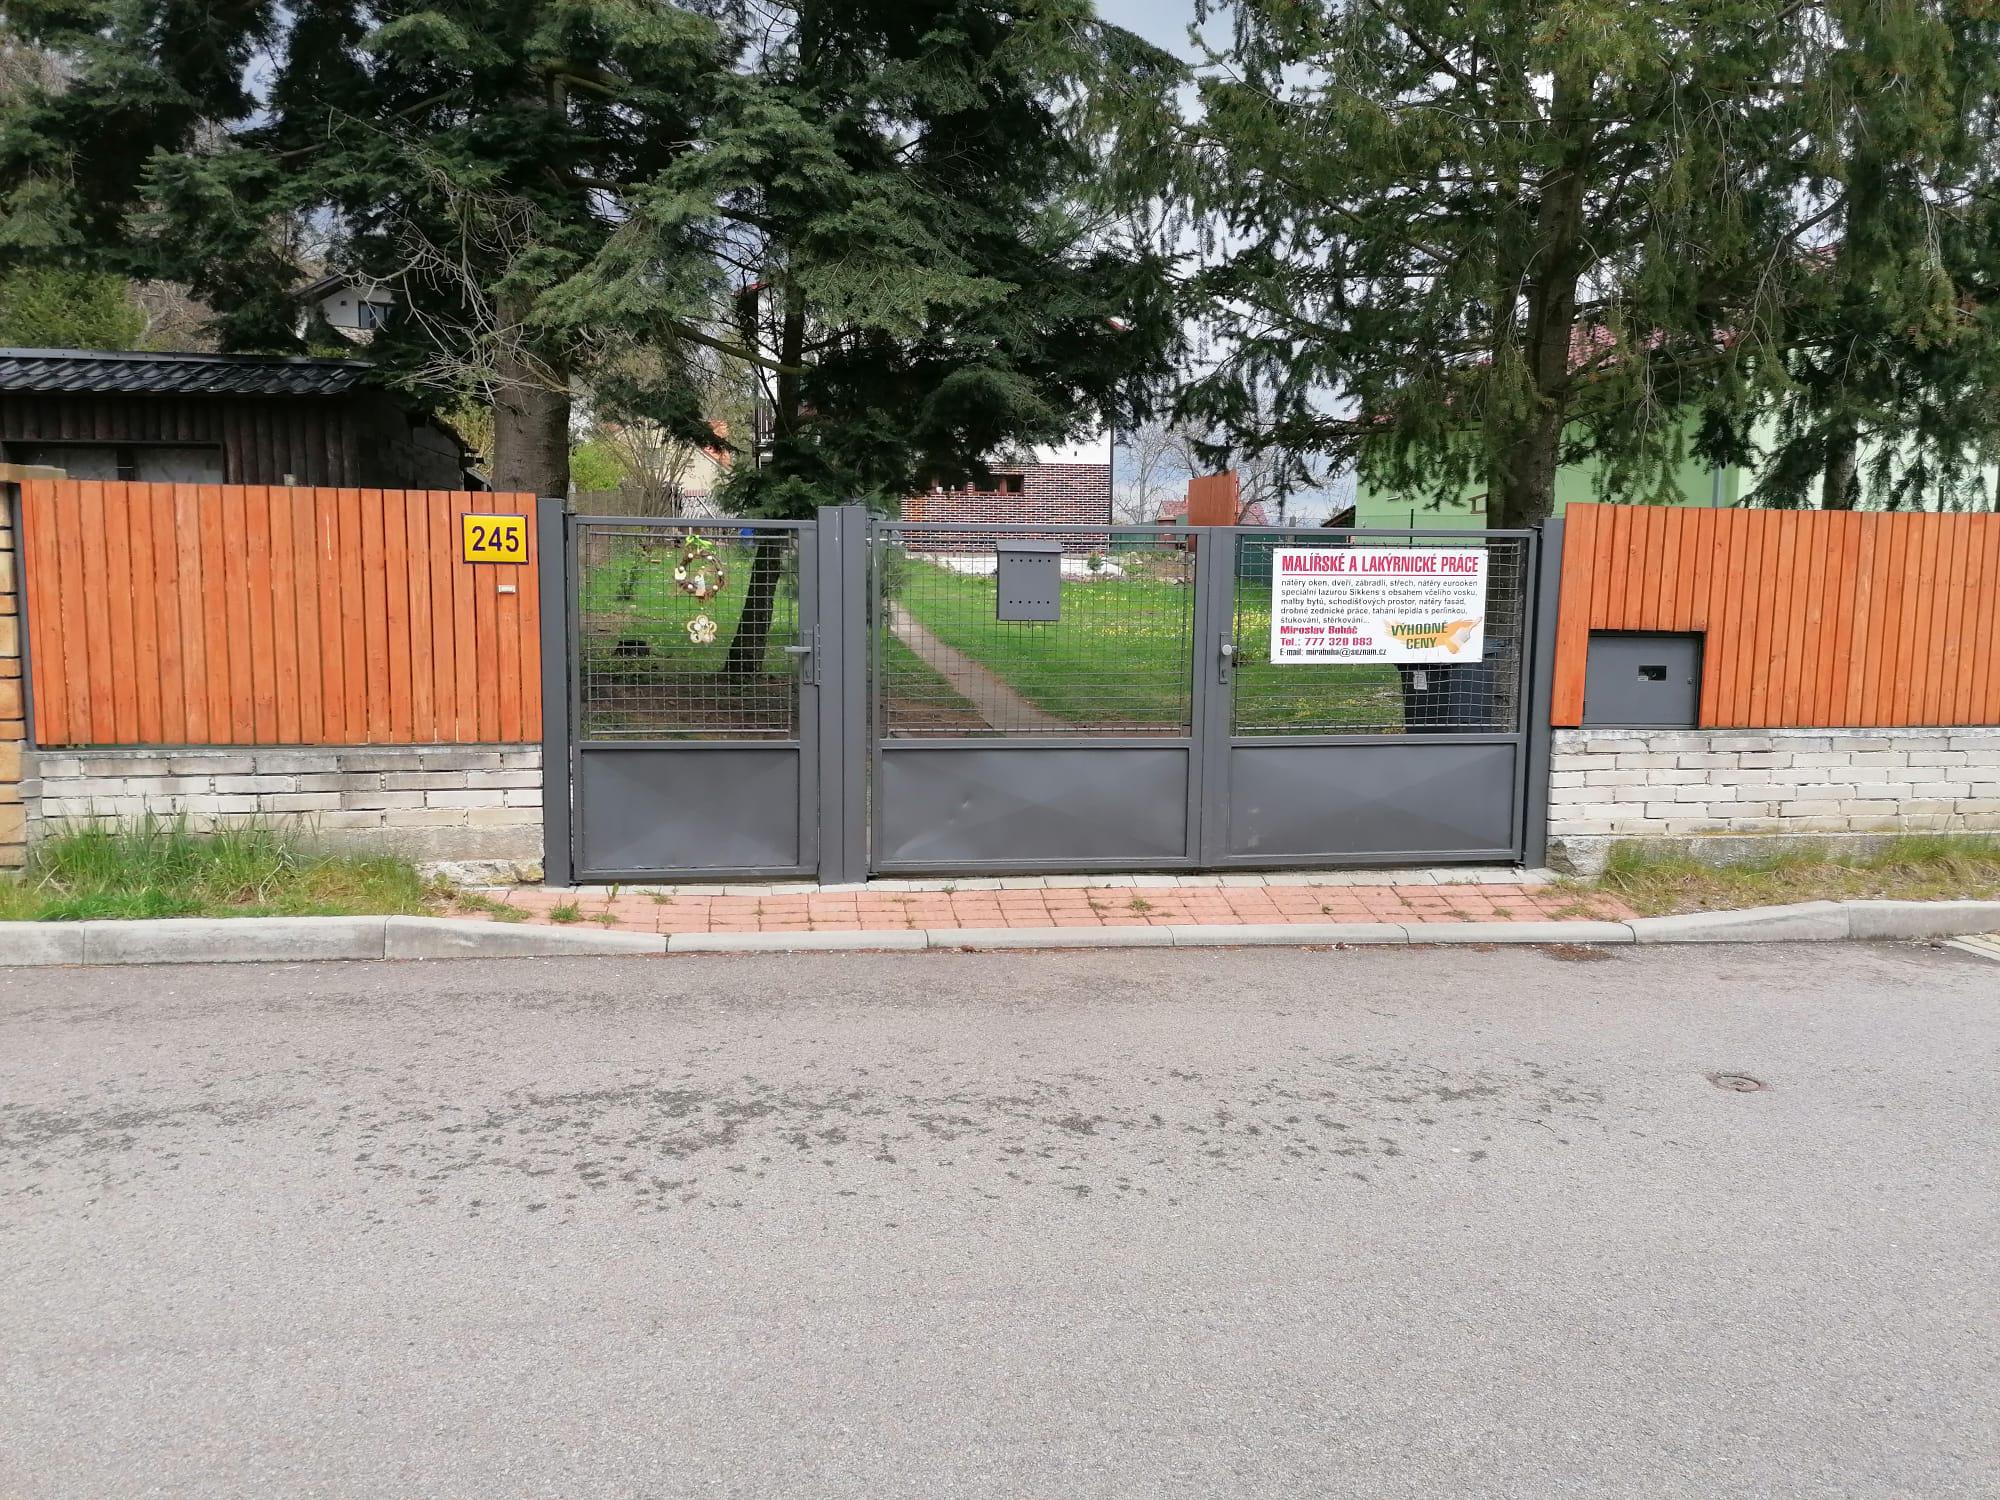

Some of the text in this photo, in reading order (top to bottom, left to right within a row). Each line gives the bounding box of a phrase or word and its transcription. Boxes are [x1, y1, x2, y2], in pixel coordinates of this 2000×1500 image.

[472, 525, 520, 552] 245
[1282, 553, 1479, 573] MALÍŘSKÉ A LAKÝRNICKÉ PRÁCE
[1281, 579, 1305, 587] nátěry
[1308, 579, 1330, 587] oken,
[1331, 579, 1354, 587] dveří,
[1389, 579, 1416, 588] střech,
[1417, 579, 1441, 588] nátěry
[1281, 588, 1317, 597] speciální
[1318, 588, 1347, 596] lazurou
[1349, 588, 1380, 596] Sikkens
[1388, 588, 1423, 596] obsahem
[1453, 588, 1478, 597] vosku,
[1281, 598, 1305, 606] malby
[1306, 597, 1327, 606] bytů,
[1387, 598, 1417, 606] prostor,
[1418, 598, 1442, 606] nátěry
[1280, 607, 1308, 615] drobné
[1310, 607, 1345, 615] zednické
[1346, 607, 1371, 616] práce,
[1372, 607, 1396, 615] tahání
[1397, 607, 1423, 616] lepidla
[1280, 616, 1321, 625] štukování,
[1280, 625, 1325, 635] Miroslav
[1391, 621, 1449, 636] VÝHODNÉ
[1280, 637, 1301, 646] Tel.:
[1305, 637, 1325, 646] 777
[1406, 637, 1437, 650] CENY
